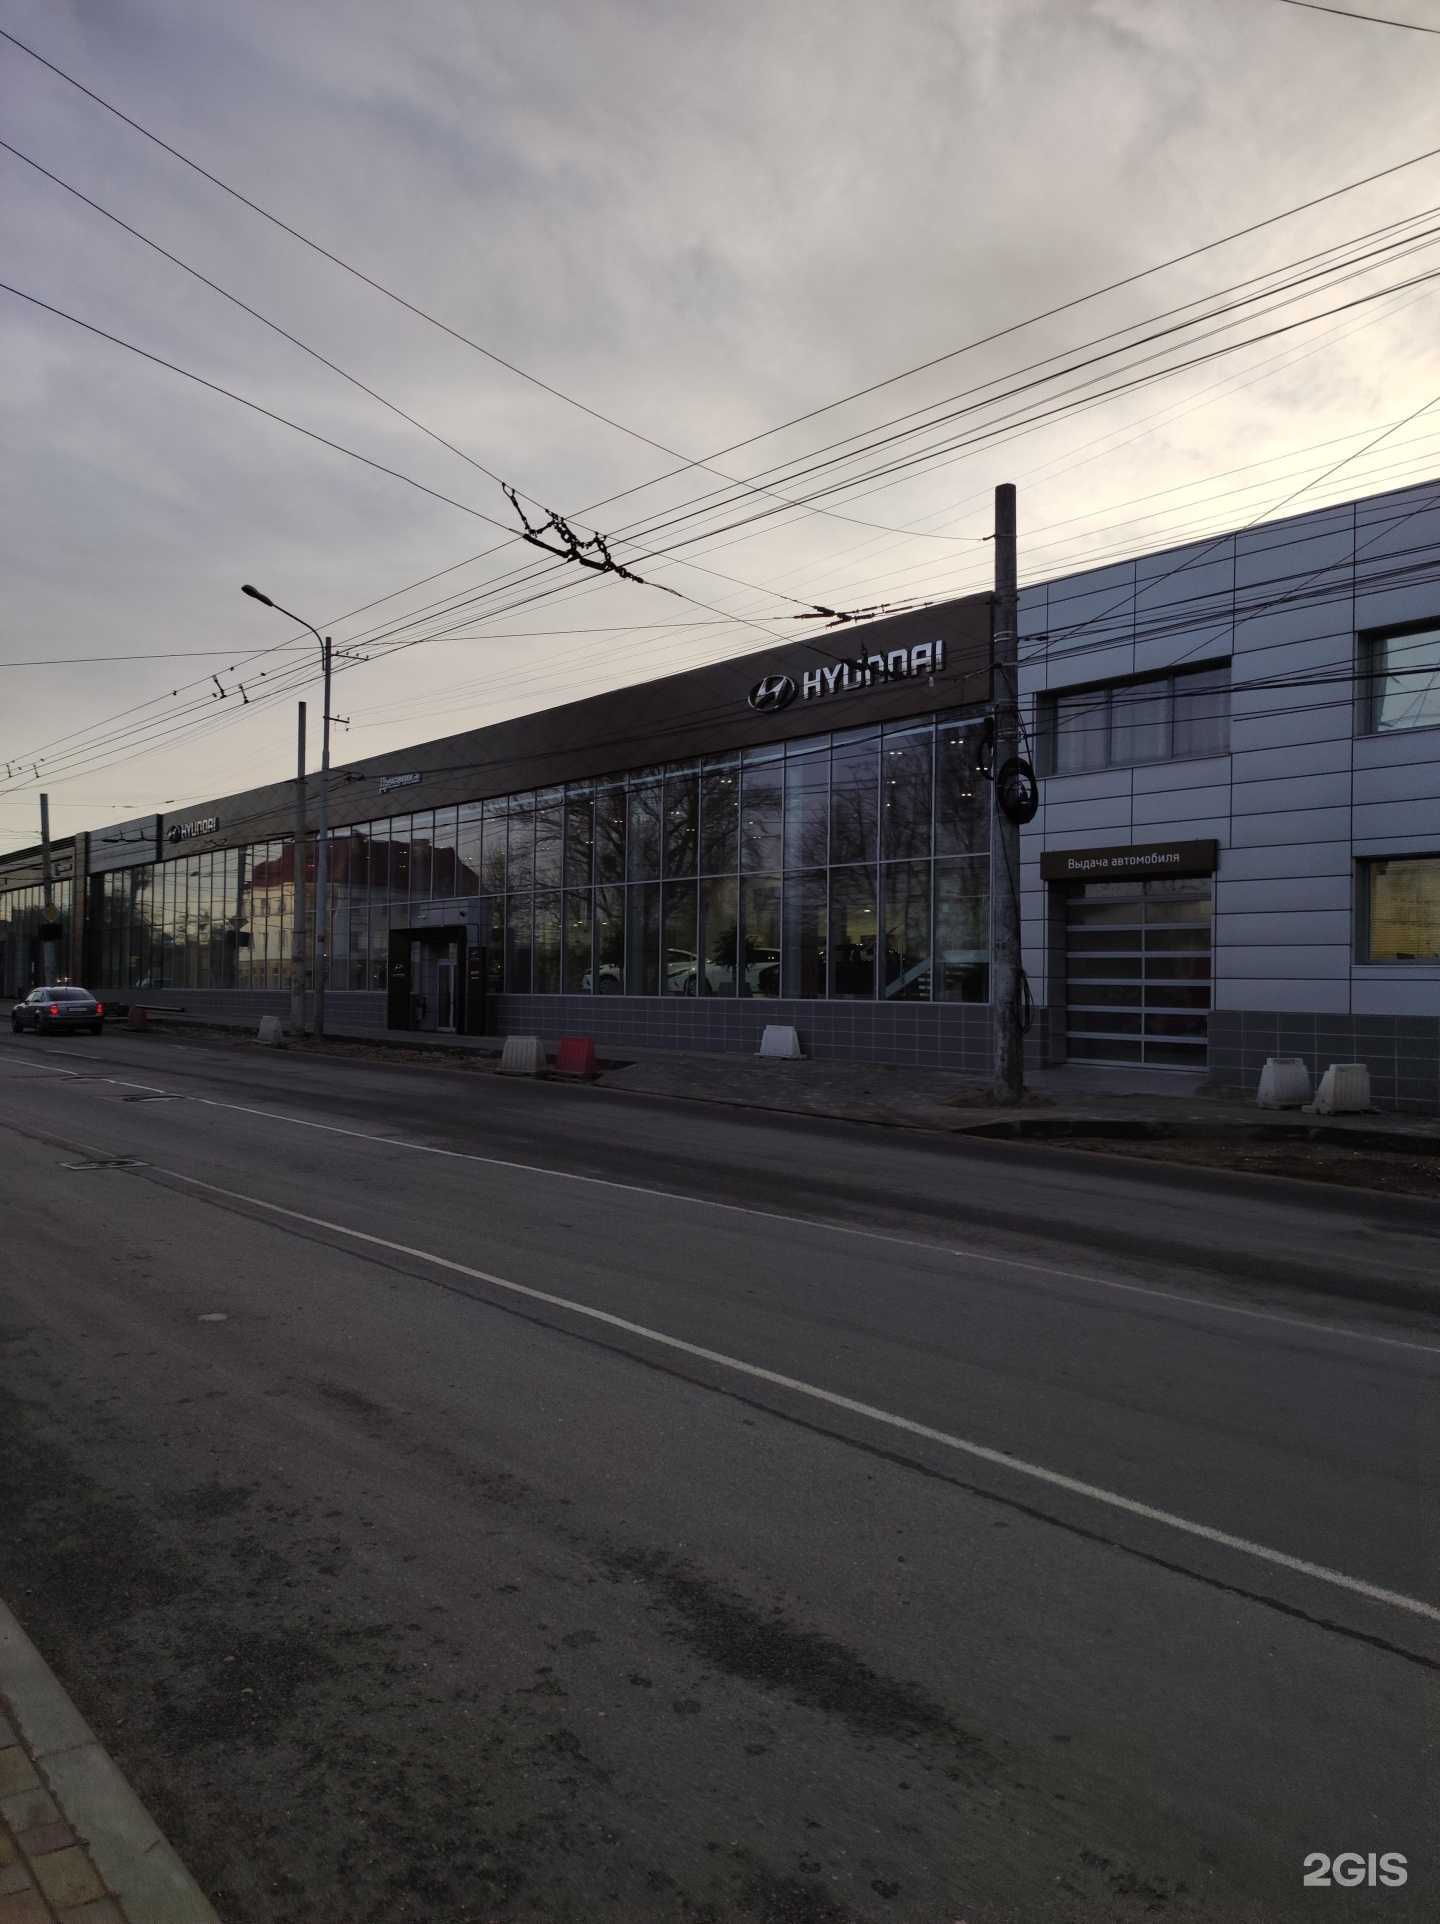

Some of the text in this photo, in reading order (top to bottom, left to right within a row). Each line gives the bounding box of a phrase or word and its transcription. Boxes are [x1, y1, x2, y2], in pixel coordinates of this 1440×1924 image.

[802, 640, 946, 699] HYUNDAI
[1067, 852, 1181, 870] Выдача автомобиля
